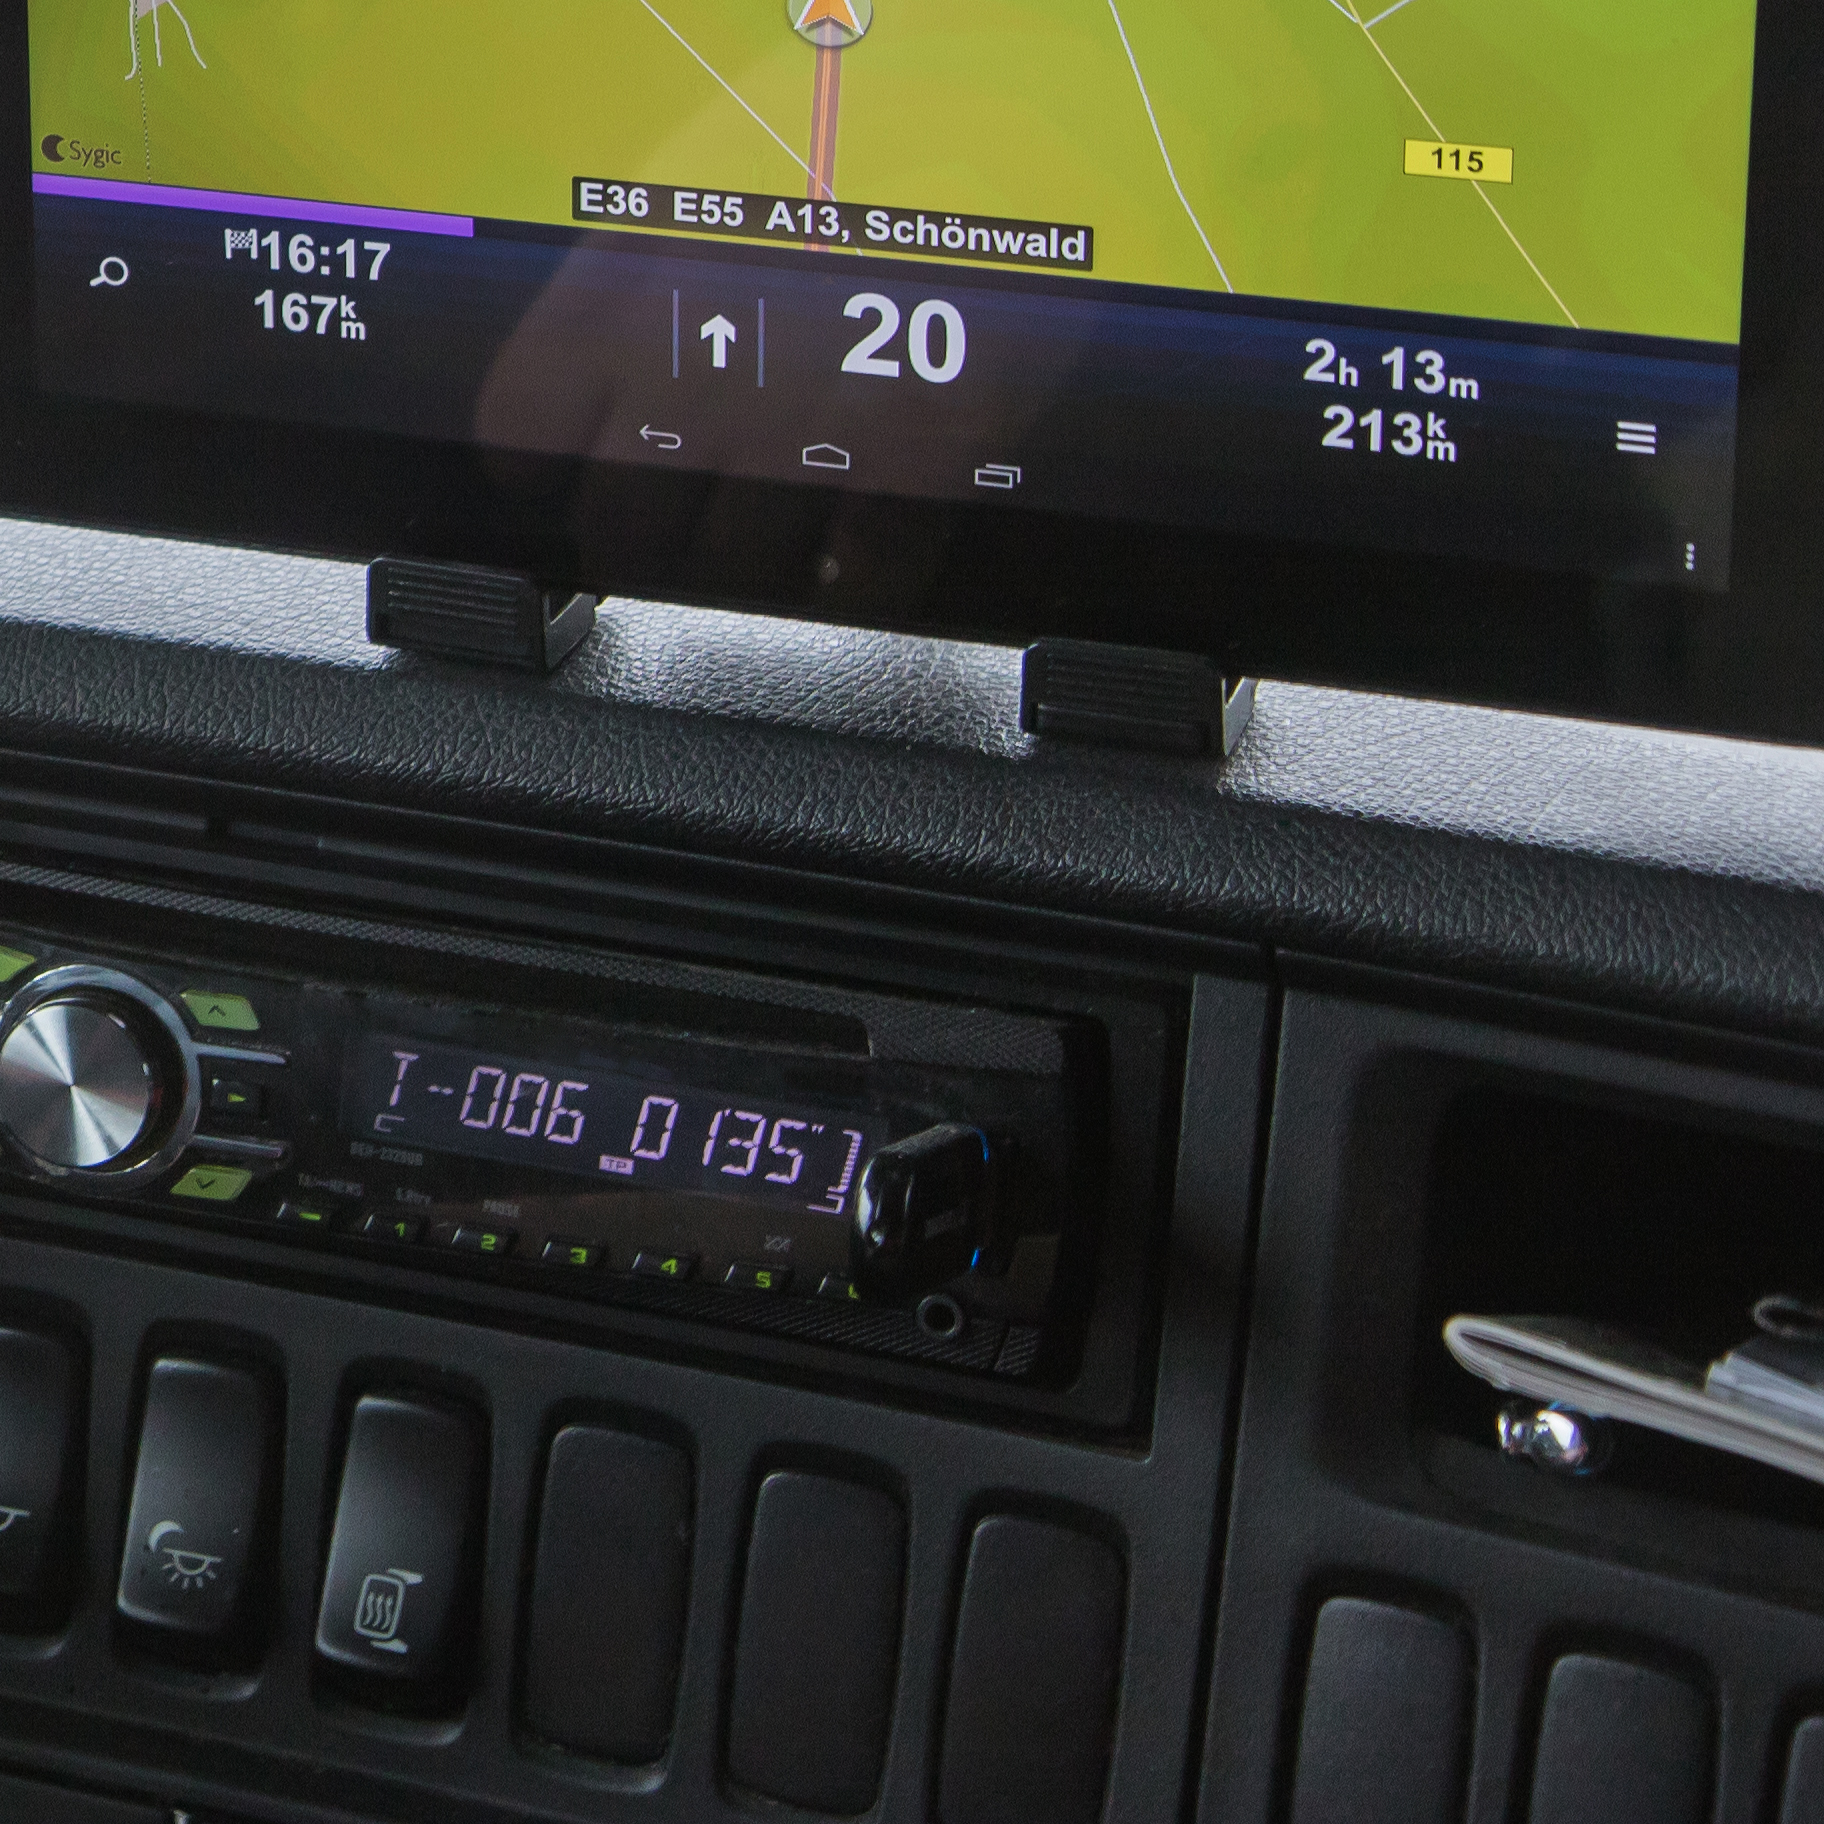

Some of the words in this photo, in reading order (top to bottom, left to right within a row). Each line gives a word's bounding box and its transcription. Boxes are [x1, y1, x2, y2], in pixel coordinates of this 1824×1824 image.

[69, 139, 122, 169] Sygic
[1433, 148, 1483, 172] 115
[581, 183, 648, 217] E36
[675, 190, 744, 227] E55
[765, 201, 851, 243] A13,
[863, 210, 1086, 261] Schönwald
[261, 229, 392, 281] 16:17
[842, 293, 965, 382] 20
[1304, 339, 1358, 386] 2h
[1382, 347, 1478, 399] 13m
[604, 1158, 630, 1174] TP
[394, 1222, 406, 1237] 1
[481, 1234, 497, 1250] 2
[570, 1247, 588, 1263] 3
[661, 1258, 677, 1274] 4
[755, 1272, 772, 1288] 5
